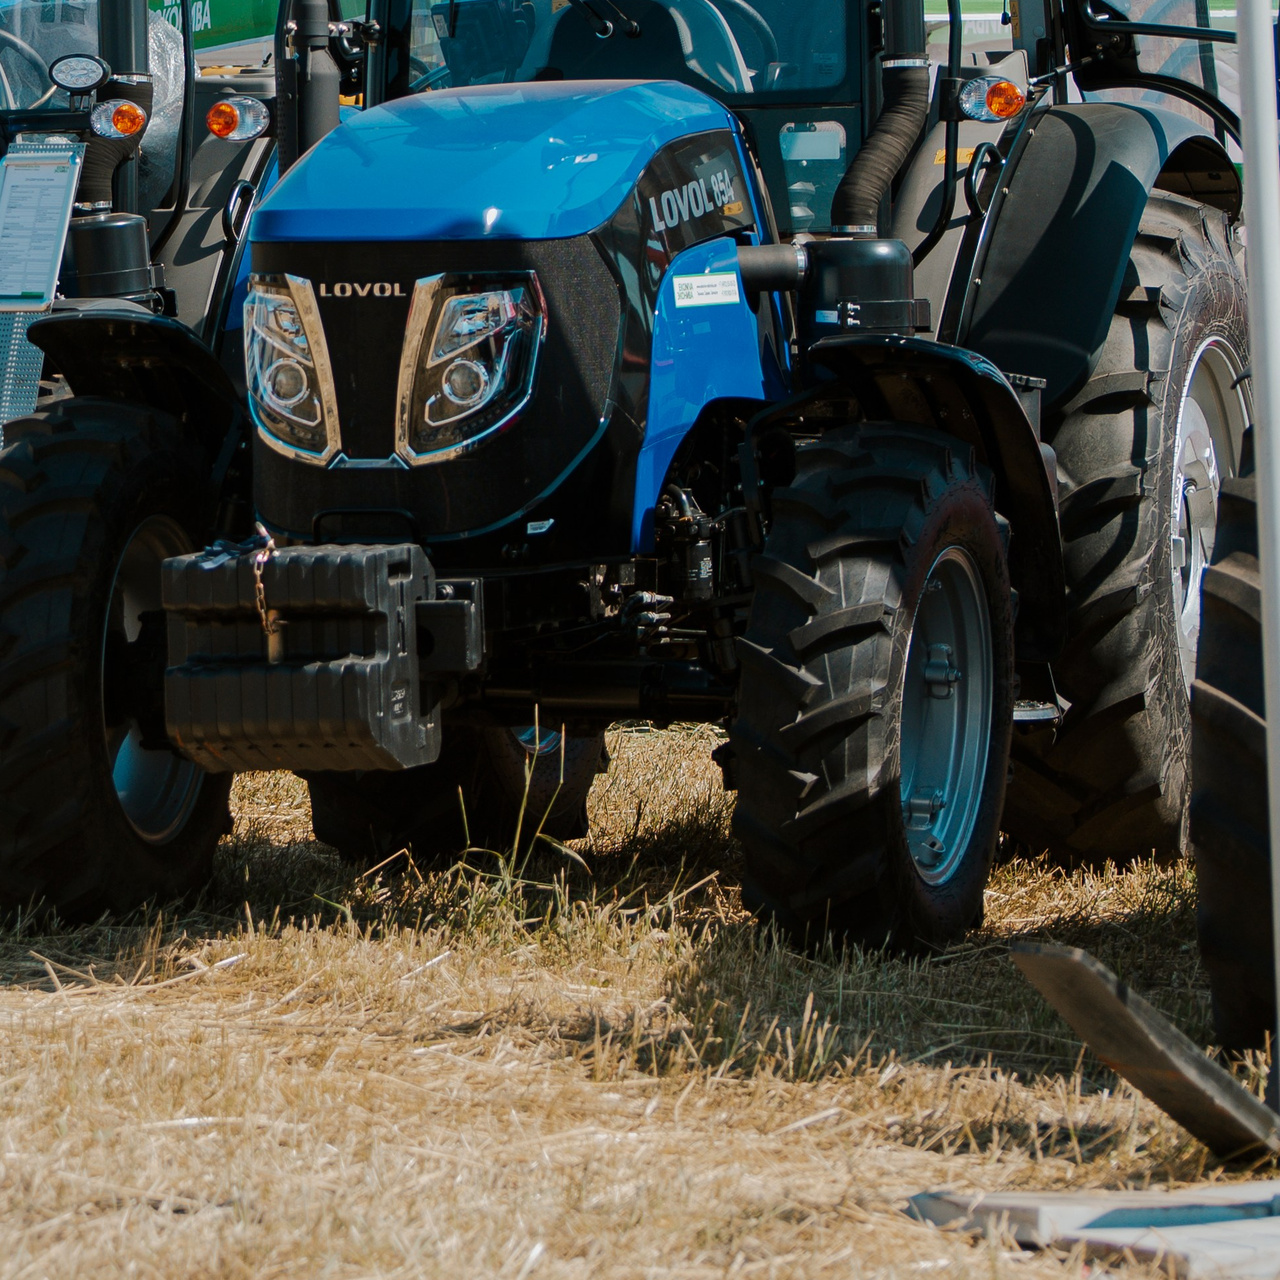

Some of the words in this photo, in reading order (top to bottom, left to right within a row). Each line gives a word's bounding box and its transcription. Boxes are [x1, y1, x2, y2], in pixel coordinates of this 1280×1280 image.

[649, 178, 715, 233] LOVOL
[710, 168, 735, 208] 854
[319, 282, 407, 297] LOVOL
